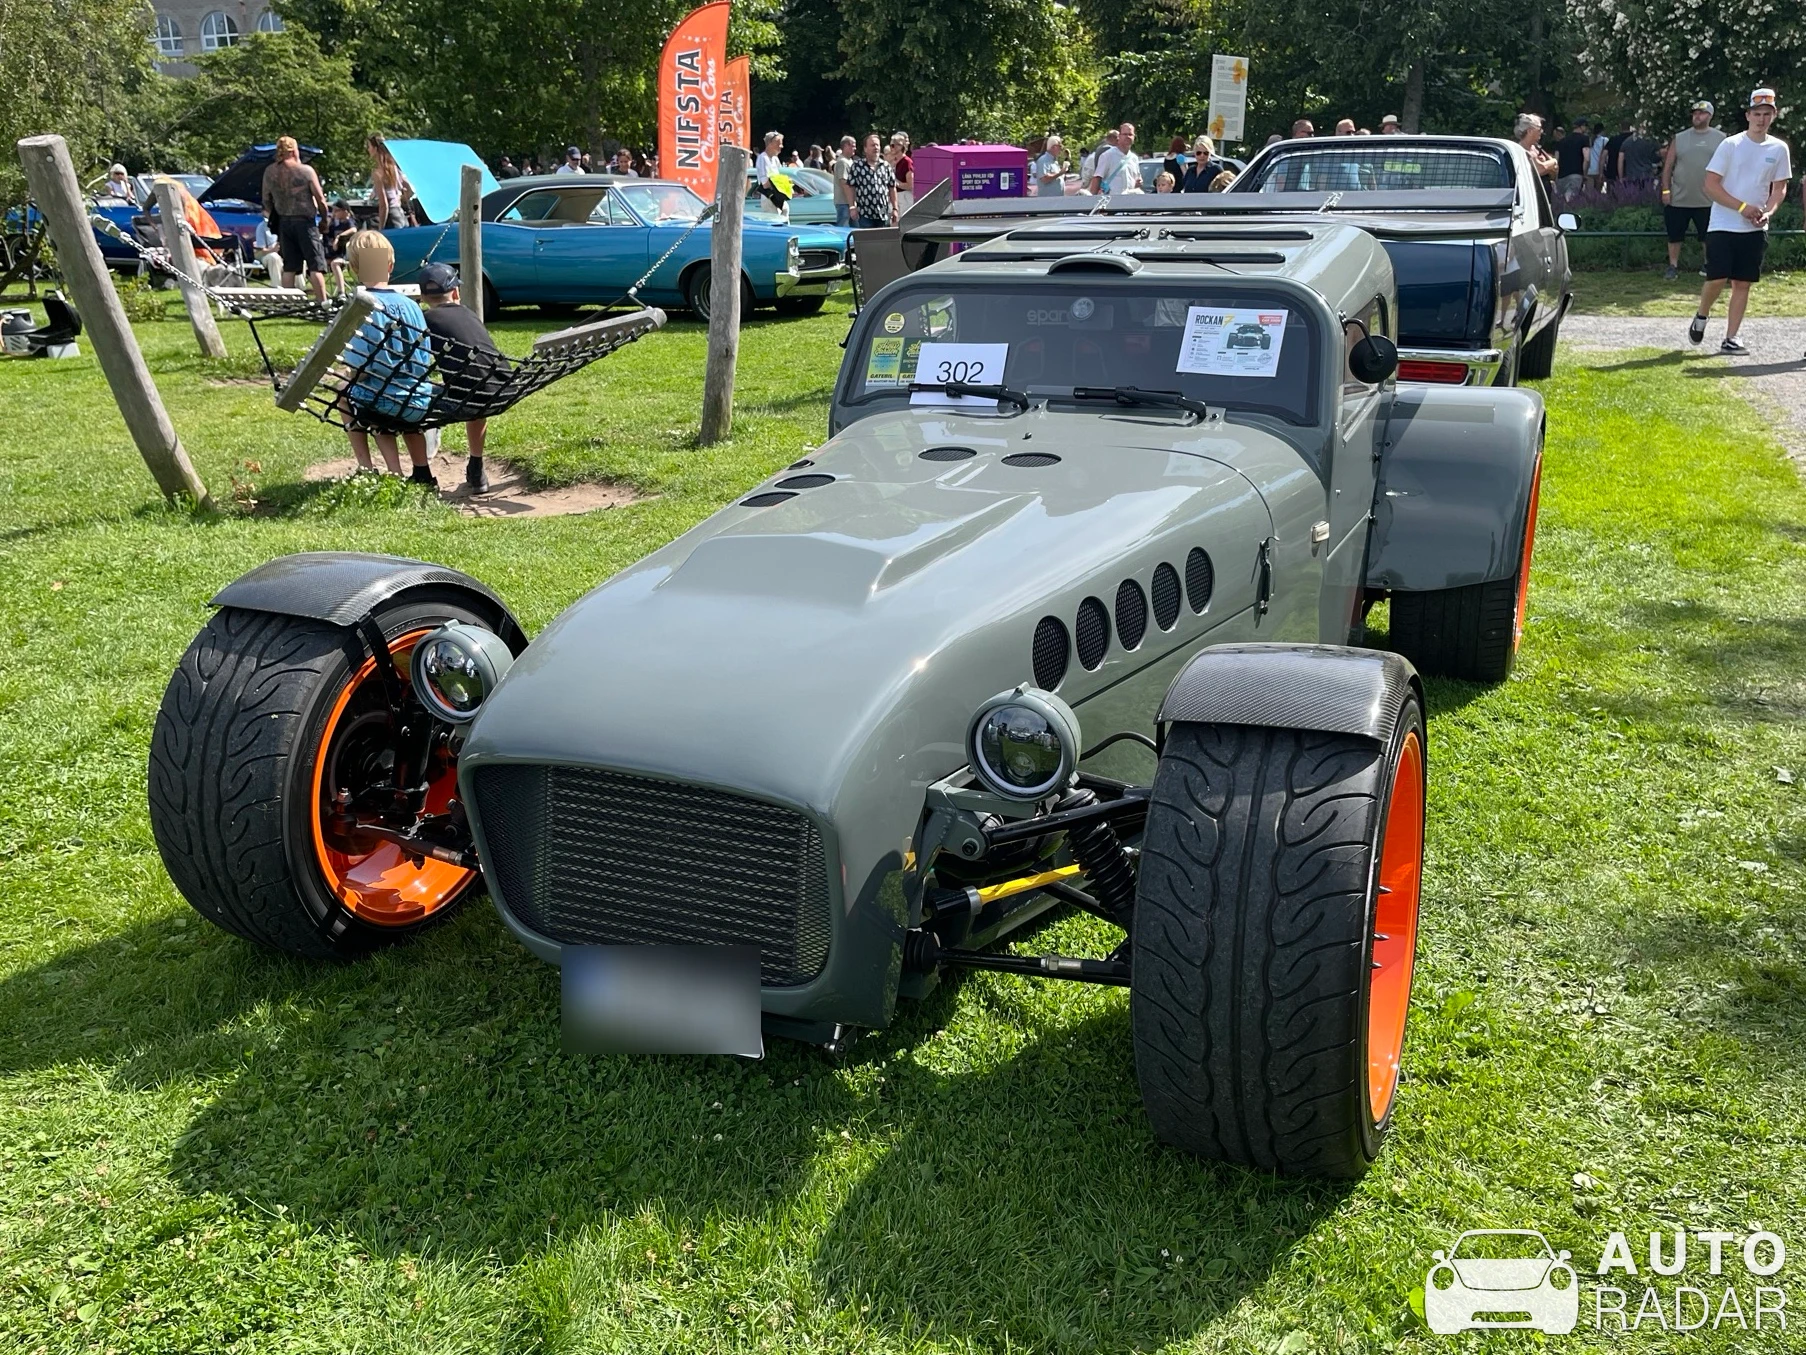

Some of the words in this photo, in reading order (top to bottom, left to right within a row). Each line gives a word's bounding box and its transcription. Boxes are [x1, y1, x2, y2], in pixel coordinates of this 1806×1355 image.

[701, 58, 716, 100] Cars
[676, 49, 702, 170] NIFSTA
[701, 104, 716, 163] Classic
[719, 91, 733, 146] FSTA
[1195, 314, 1224, 326] ROCKAN
[936, 361, 984, 383] 302
